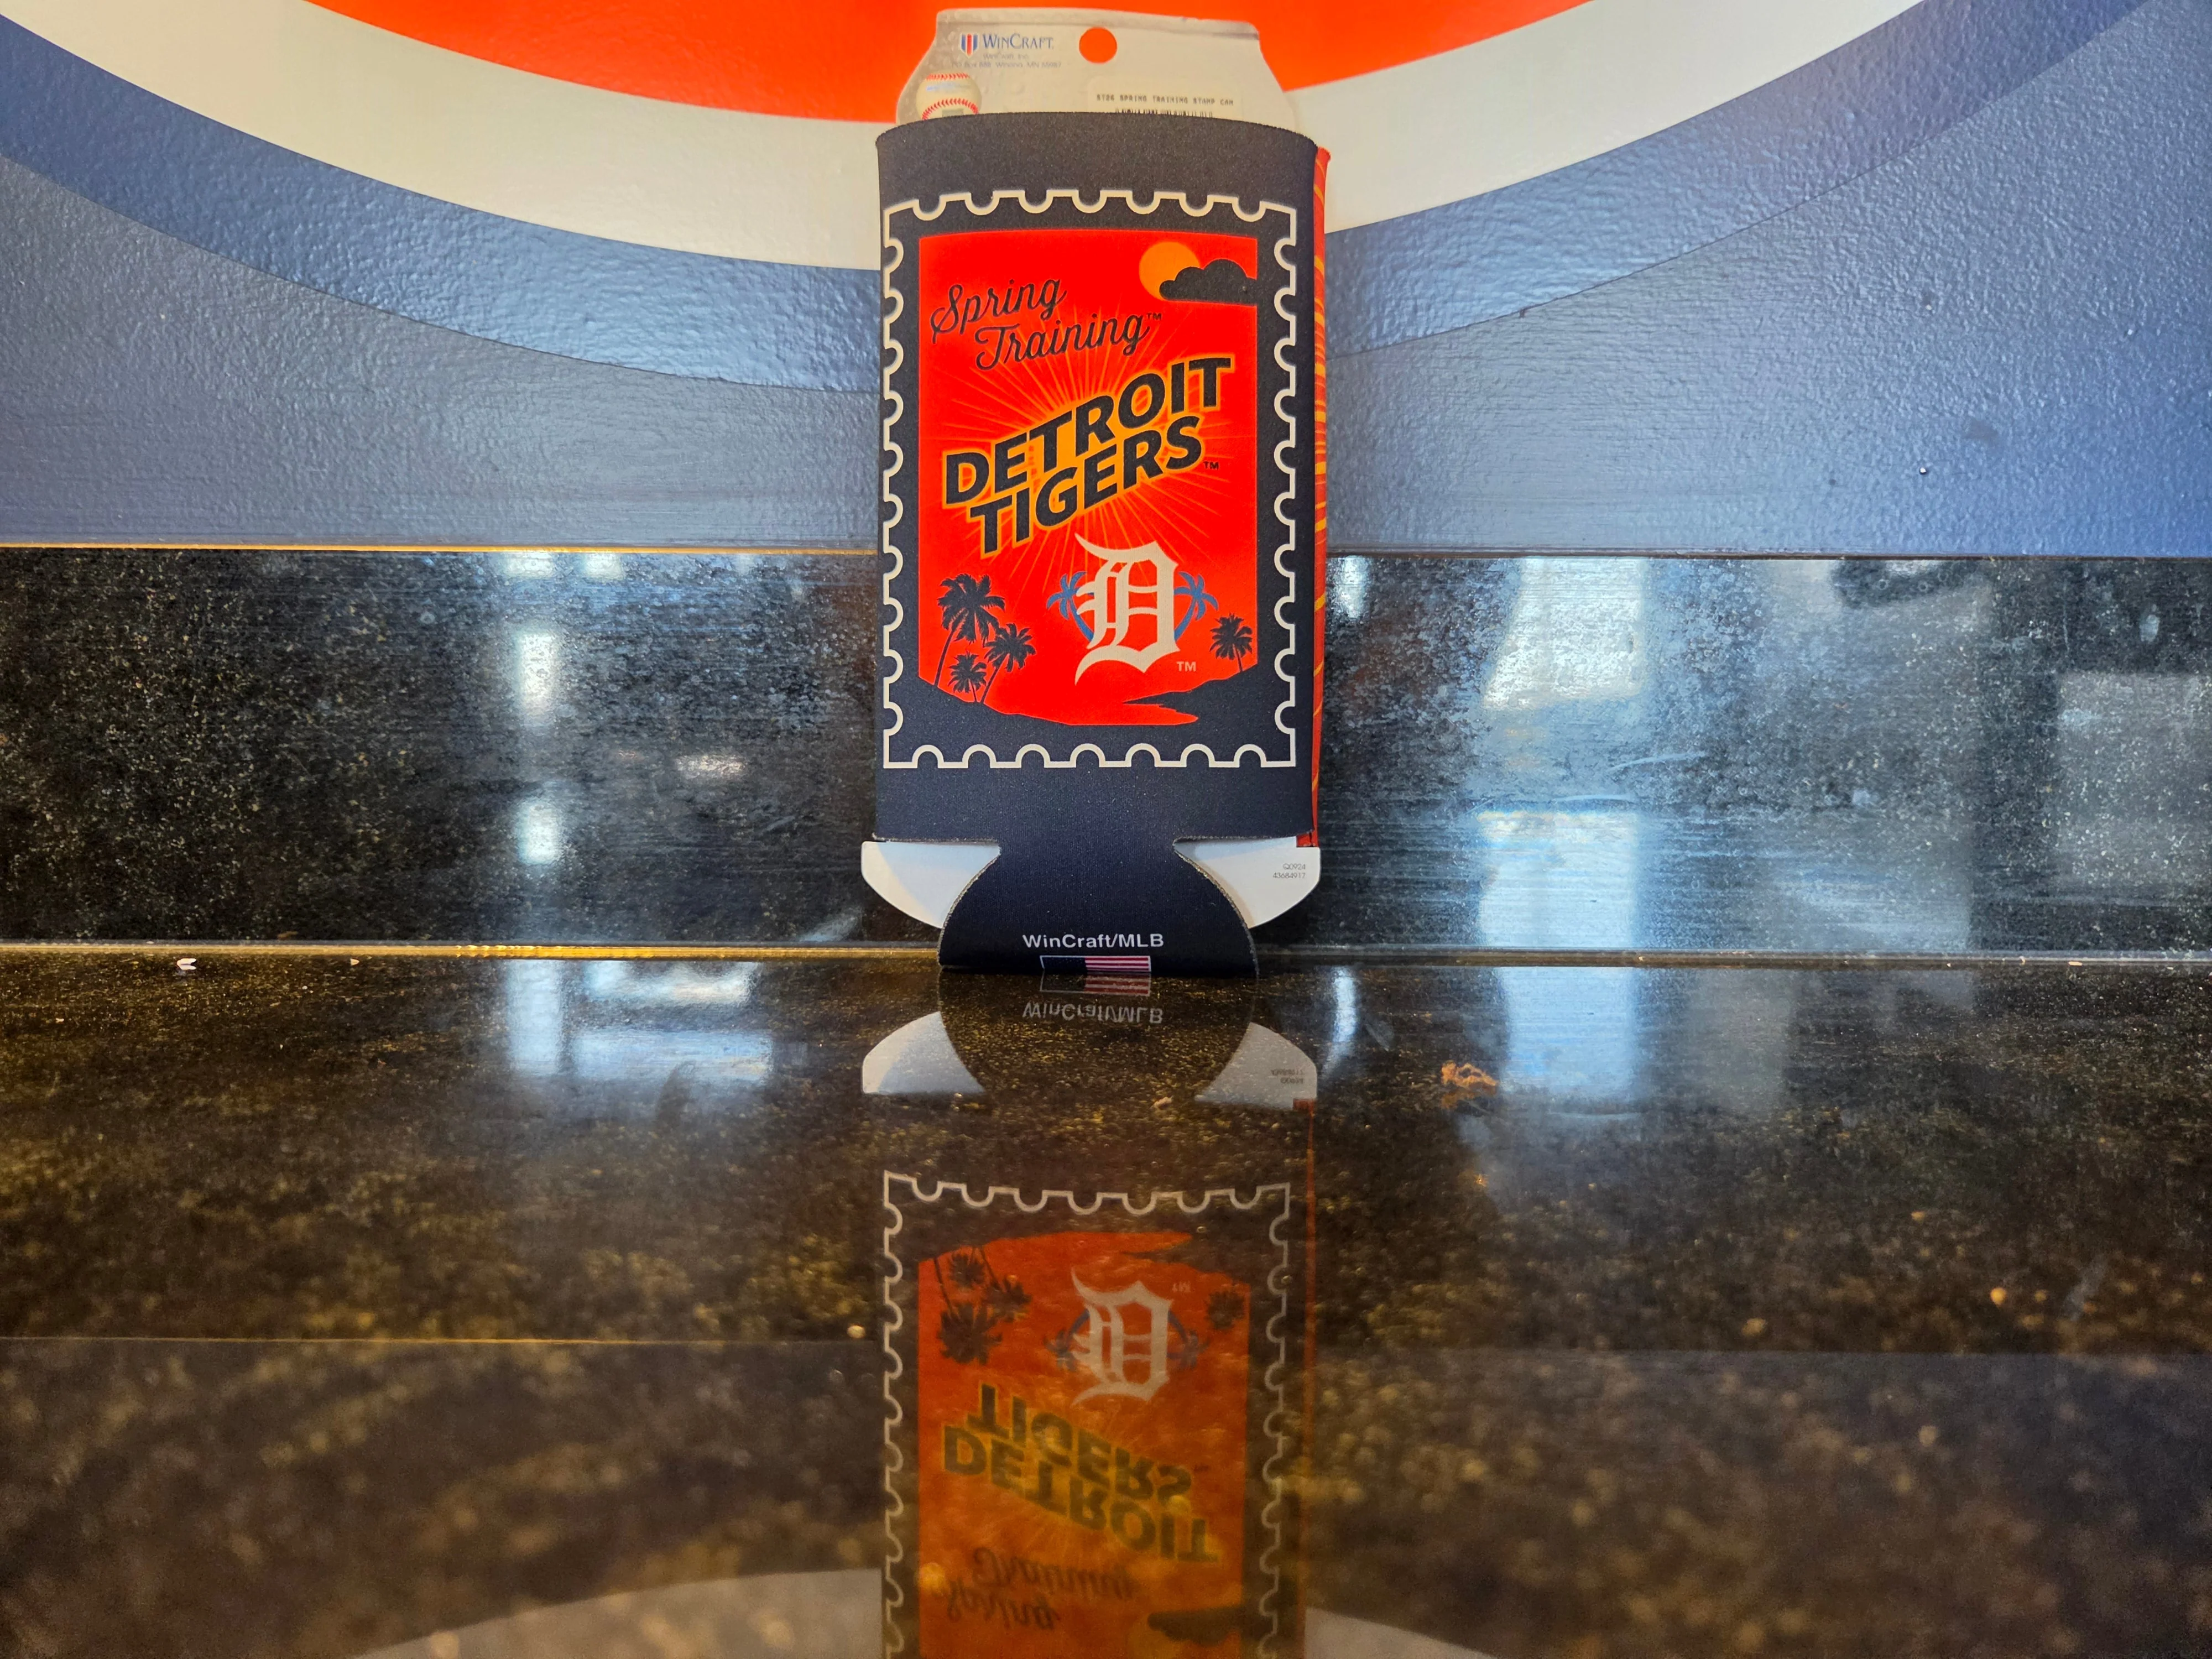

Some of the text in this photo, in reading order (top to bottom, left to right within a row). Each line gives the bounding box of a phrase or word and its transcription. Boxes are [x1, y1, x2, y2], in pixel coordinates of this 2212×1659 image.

[1152, 95, 1188, 104] TRAINING
[930, 278, 1068, 344] Spring
[975, 312, 1151, 370] Training
[945, 357, 1232, 505] DETROIT
[969, 415, 1203, 555] TIGERS
[1074, 534, 1181, 685] D
[1022, 933, 1164, 948] WinCraft/MLB
